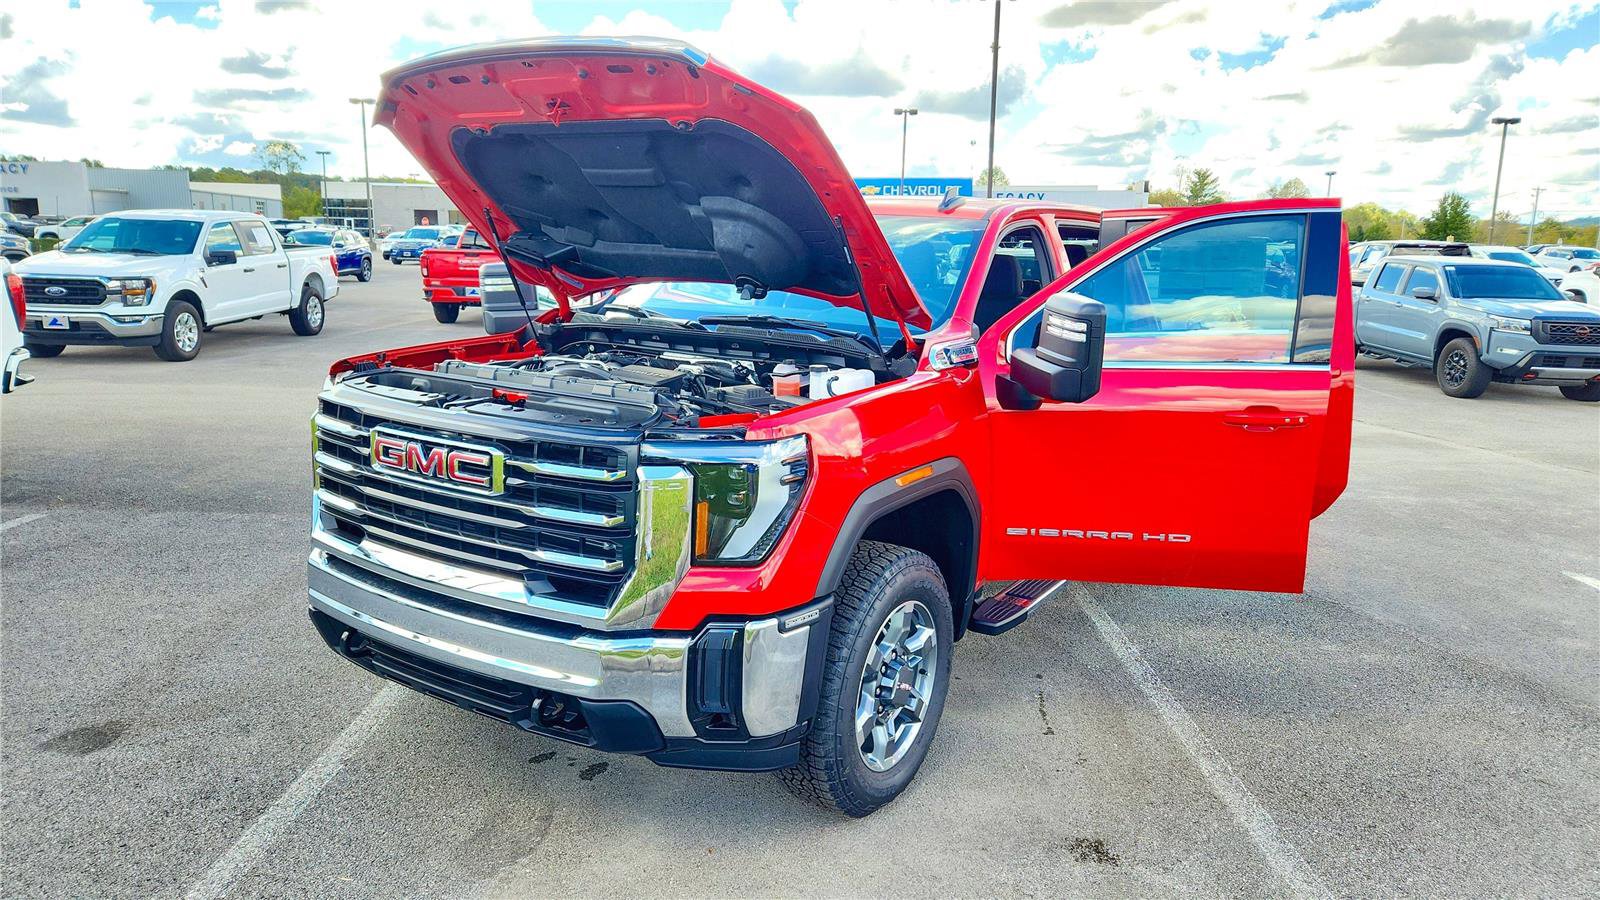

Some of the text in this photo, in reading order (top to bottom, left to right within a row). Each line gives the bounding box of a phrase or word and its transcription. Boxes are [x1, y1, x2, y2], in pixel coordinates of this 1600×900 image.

[882, 185, 962, 196] CHEVROLT
[373, 436, 491, 487] GMC
[1006, 527, 1192, 543] SIERRA HD
